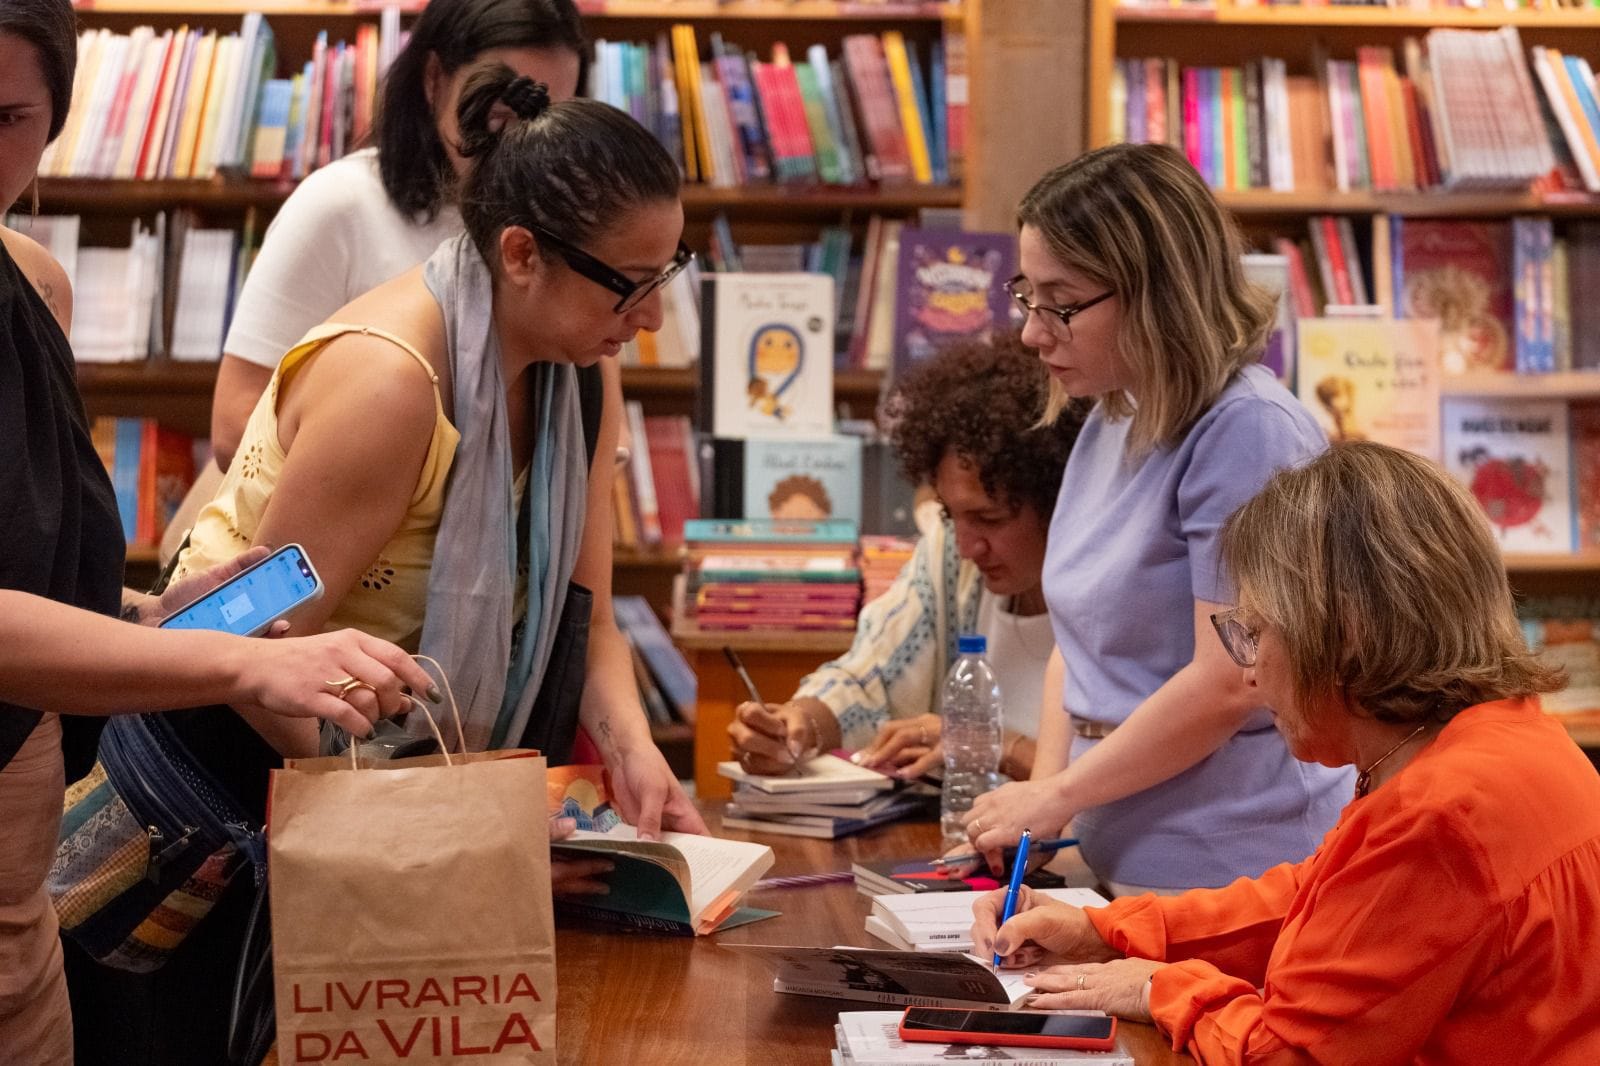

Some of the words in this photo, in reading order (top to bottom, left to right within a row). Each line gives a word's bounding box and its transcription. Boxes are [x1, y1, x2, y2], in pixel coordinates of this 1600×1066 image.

[293, 973, 542, 1014] LIVRARIA
[295, 1031, 370, 1063] DA
[376, 1013, 543, 1059] VILA
